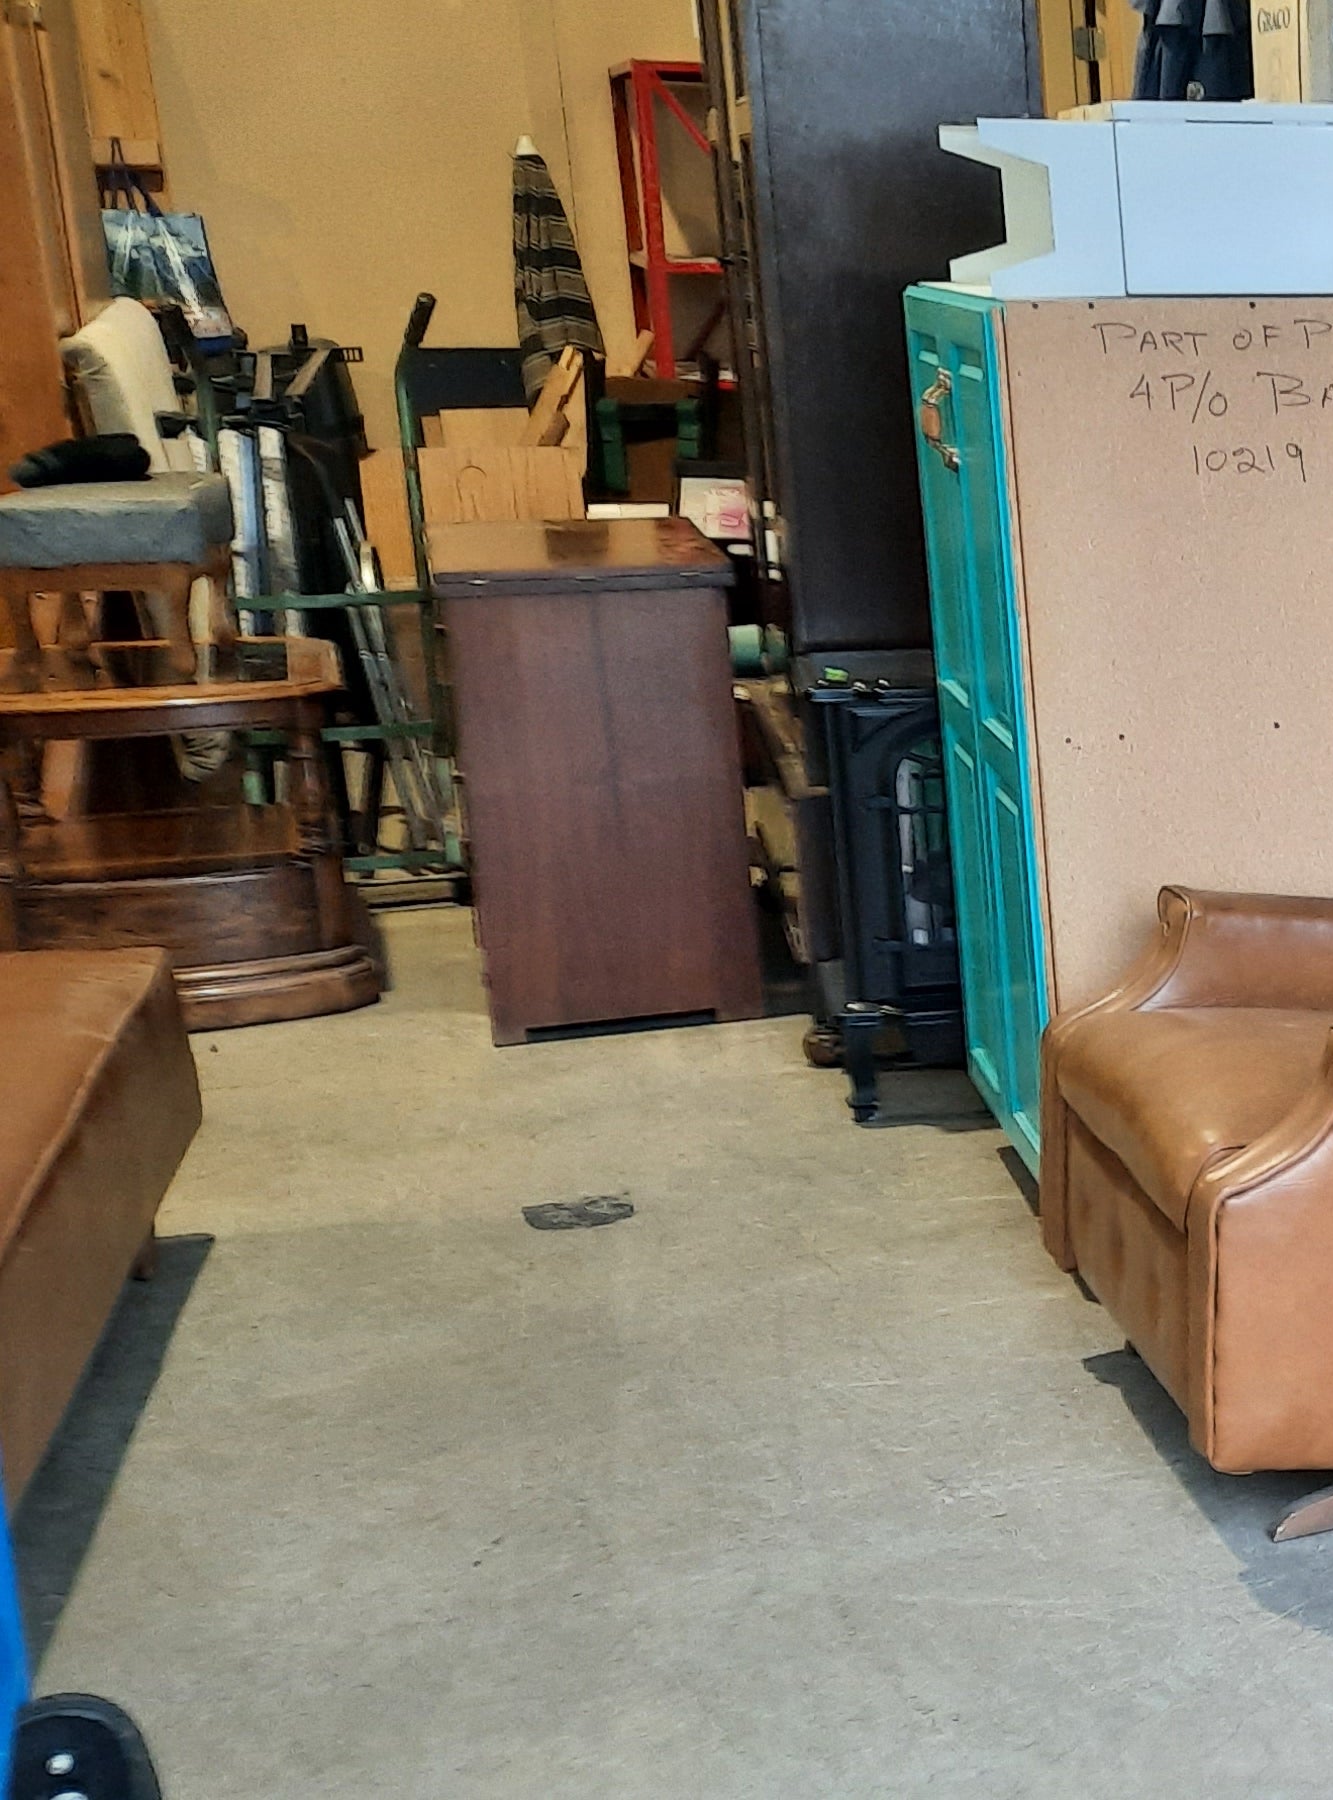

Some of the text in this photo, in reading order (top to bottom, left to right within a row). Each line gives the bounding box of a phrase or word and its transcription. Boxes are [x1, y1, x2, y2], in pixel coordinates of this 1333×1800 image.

[1091, 321, 1207, 354] PART
[1232, 325, 1282, 352] OF
[1192, 443, 1307, 483] 10219
